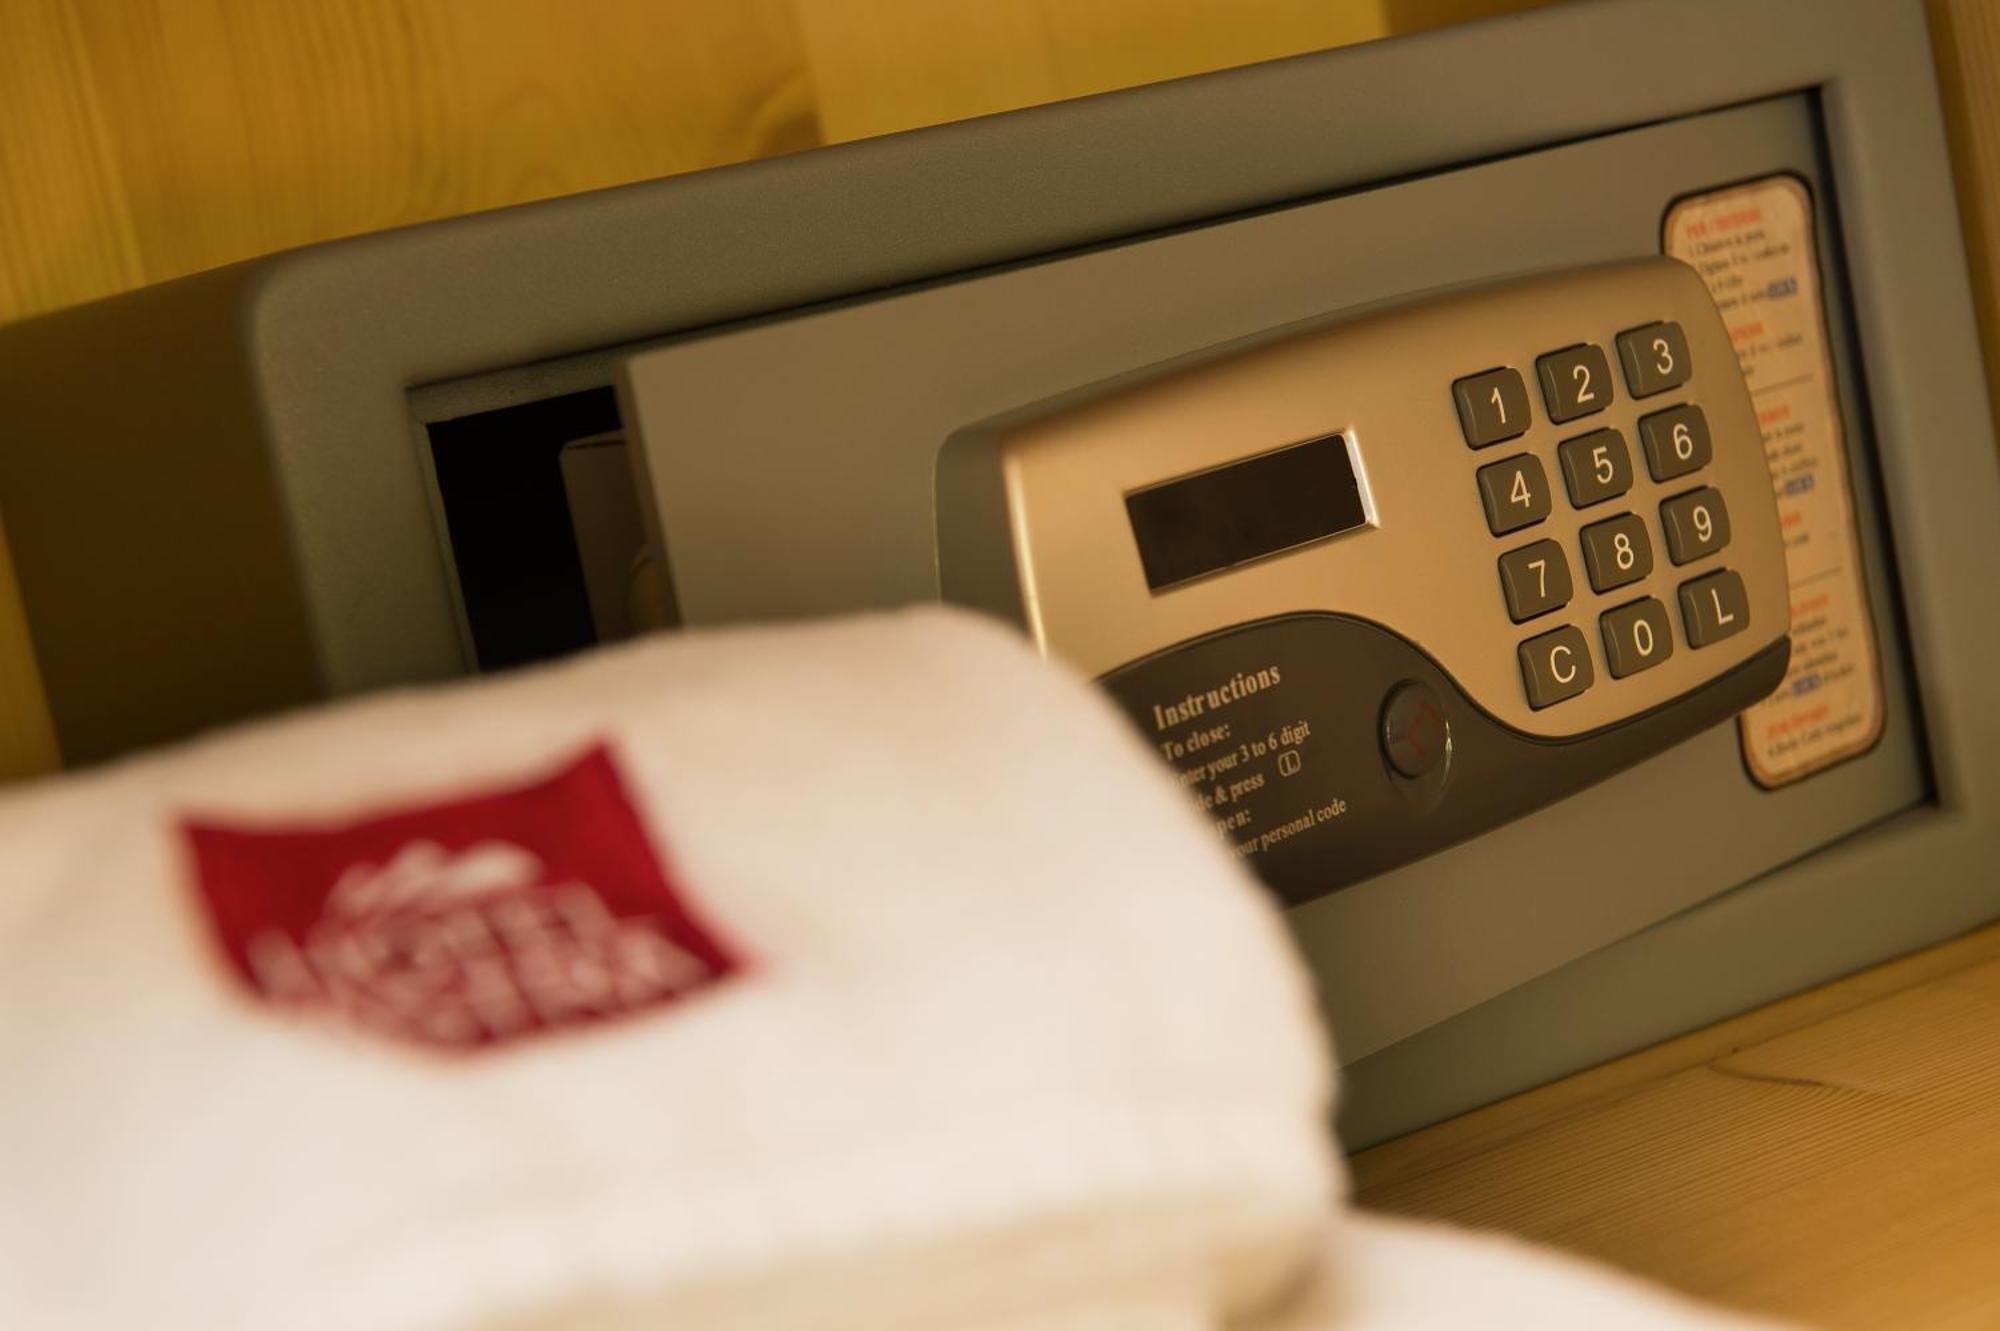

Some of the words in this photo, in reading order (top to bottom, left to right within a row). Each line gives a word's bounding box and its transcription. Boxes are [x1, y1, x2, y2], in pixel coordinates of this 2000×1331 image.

[1491, 387, 1507, 425] 1
[1573, 364, 1595, 403] 2
[1653, 338, 1674, 375] 3
[1510, 470, 1532, 508] 4
[1592, 446, 1613, 485] 5
[1672, 423, 1693, 461] 6
[1528, 559, 1547, 598] 7
[1613, 532, 1634, 570] 8
[1693, 505, 1713, 542] 9
[1550, 645, 1577, 684] C
[1711, 588, 1734, 625] L
[1153, 665, 1281, 731] Instructions
[1163, 741, 1184, 760] To
[1186, 724, 1231, 752] close:
[1207, 752, 1238, 782] your
[1240, 743, 1251, 763] 3
[1252, 737, 1266, 758] to
[1268, 731, 1279, 751] 6
[1280, 719, 1312, 748] digit
[1214, 784, 1229, 805] &
[1229, 772, 1265, 802] press
[1260, 808, 1315, 853] personal
[1315, 797, 1347, 825] code
